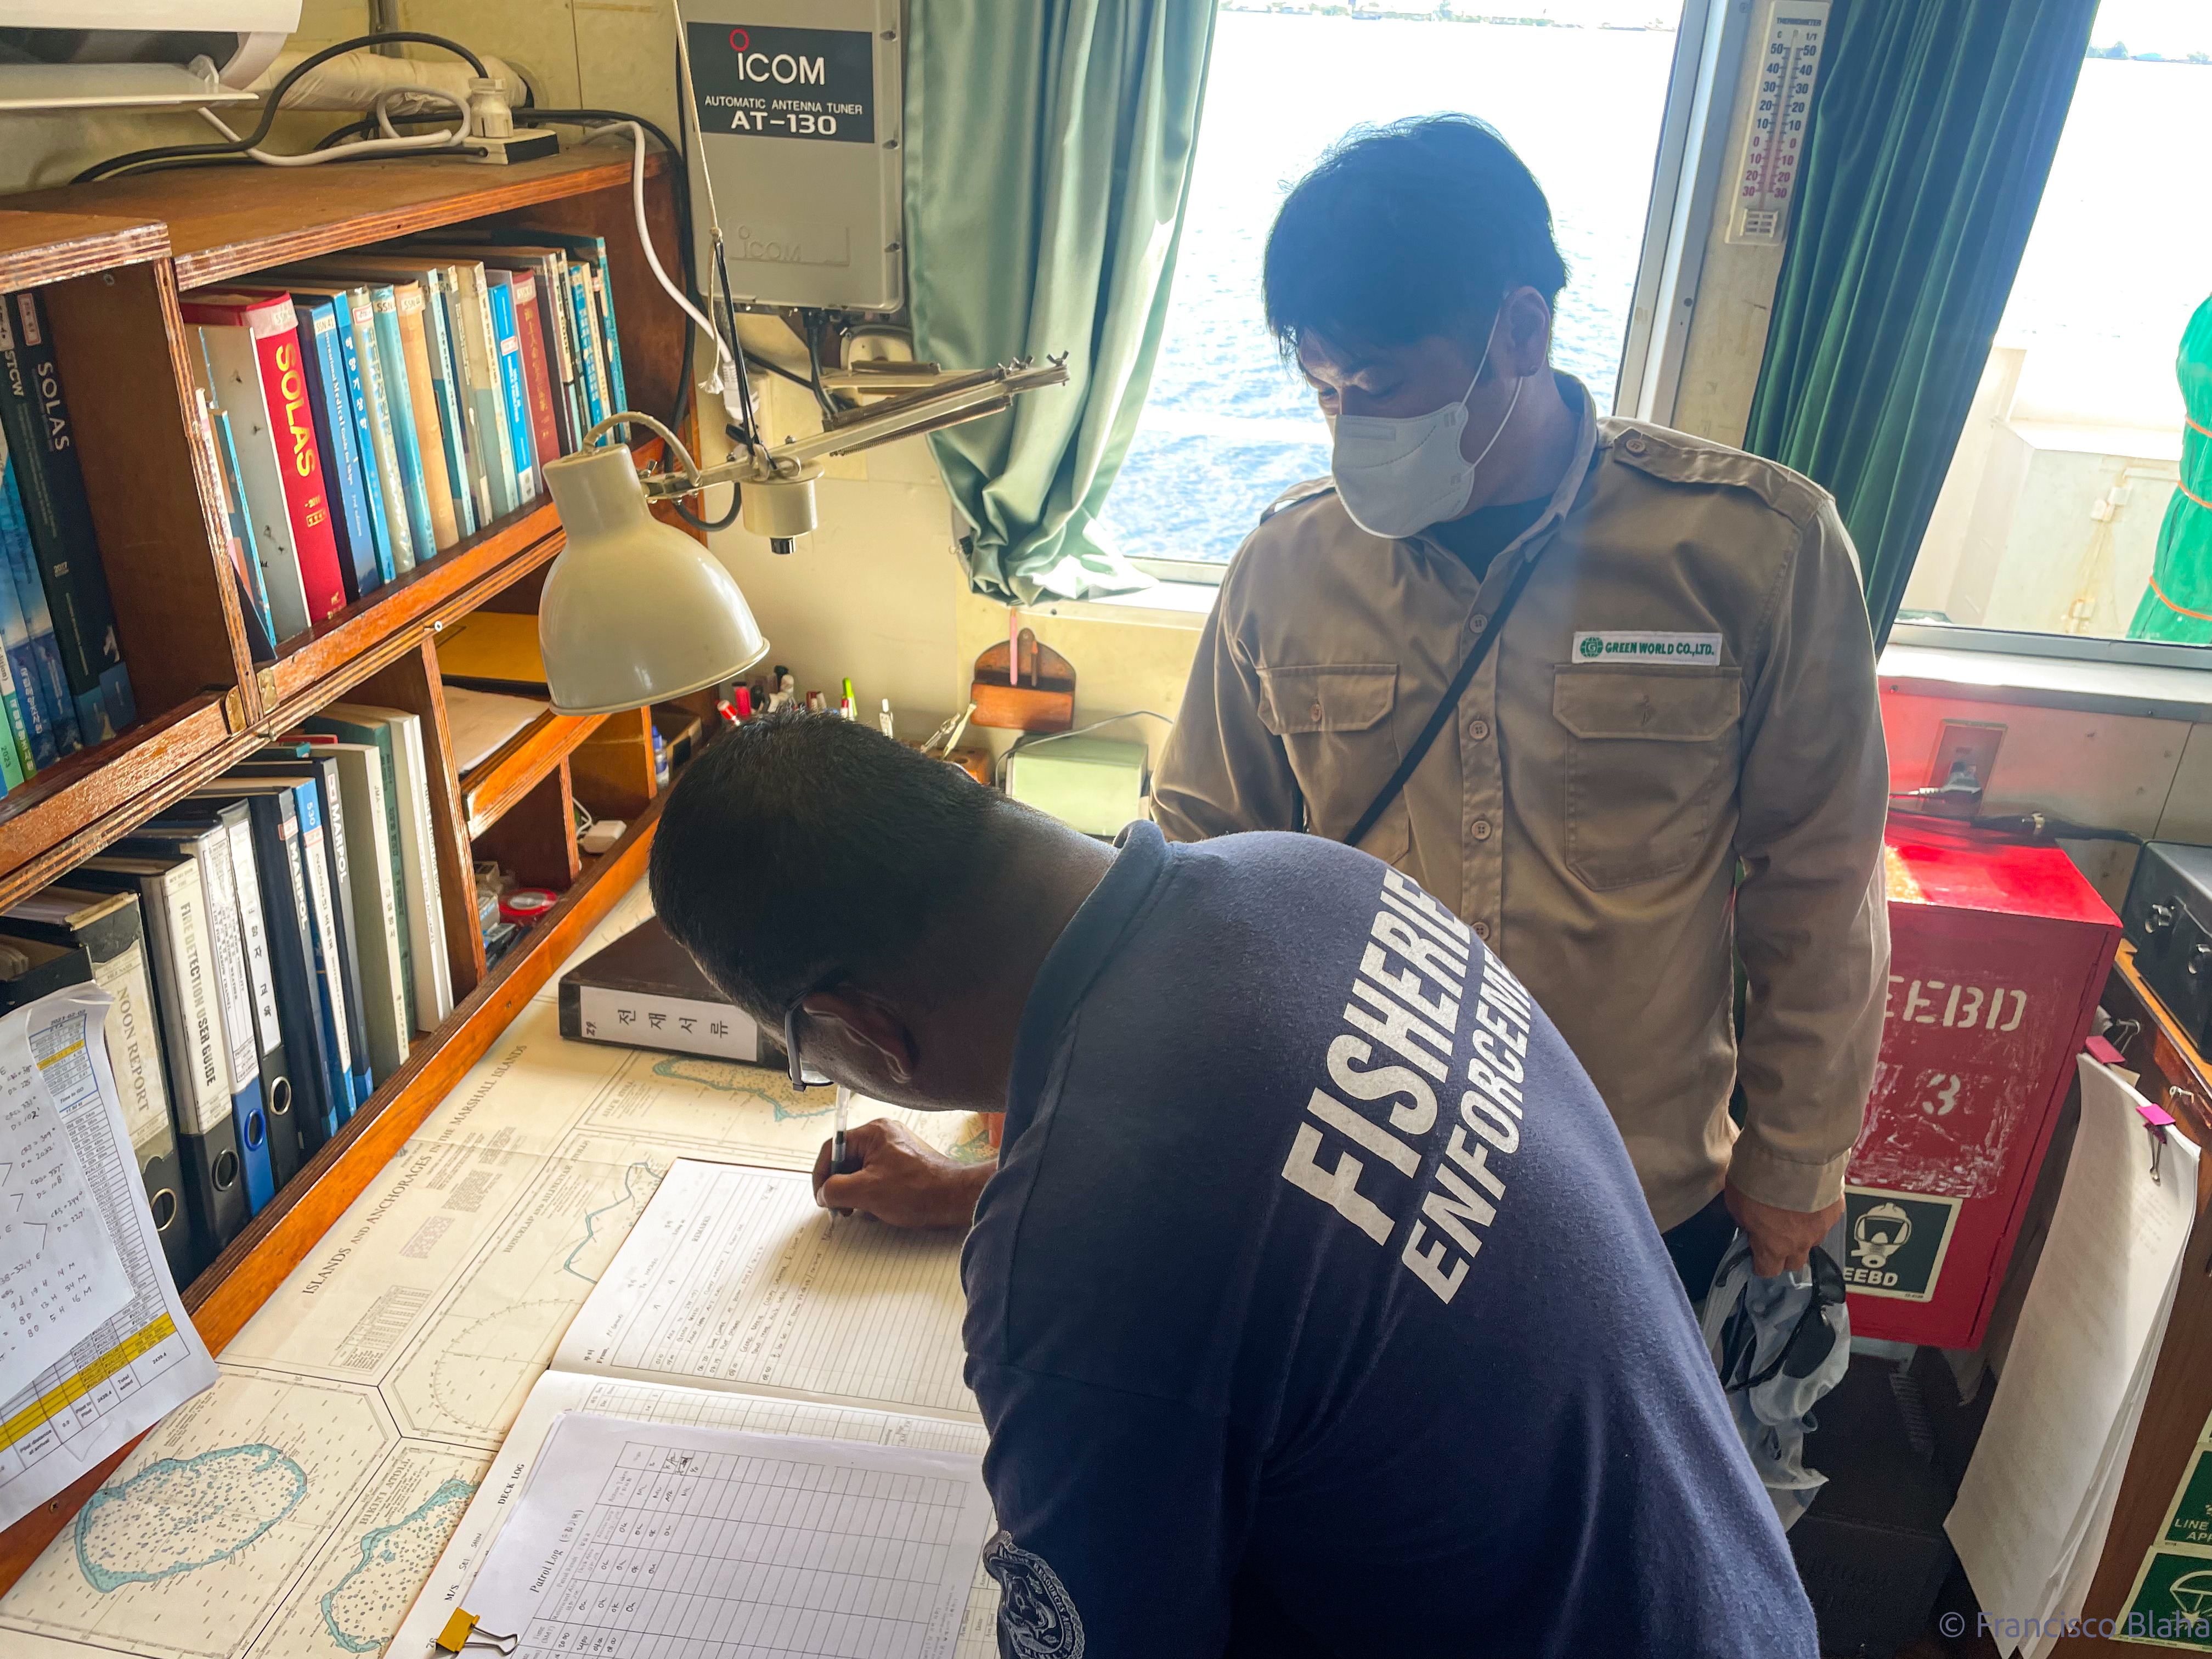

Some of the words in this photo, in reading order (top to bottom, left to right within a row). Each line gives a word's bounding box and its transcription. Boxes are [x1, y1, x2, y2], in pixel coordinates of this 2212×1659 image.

[1777, 18, 1821, 26] THERMOMETER
[1771, 43, 1783, 54] 50
[1803, 45, 1816, 56] 50
[1767, 63, 1779, 74] 40
[1799, 65, 1812, 76] 40
[1764, 82, 1776, 92] 30
[1796, 83, 1808, 94] 30
[705, 96, 766, 109] AUTOMATIC
[772, 100, 822, 113] ANTENNA
[827, 103, 862, 115] TUNER
[1760, 100, 1771, 111] 20
[1792, 102, 1804, 113] 20
[731, 110, 837, 136] AT-130
[1757, 118, 1768, 129] 10
[1789, 120, 1801, 131] 10
[1753, 137, 1759, 146] 0
[1790, 138, 1796, 149] 0
[1750, 154, 1762, 164] 10
[1782, 155, 1793, 166] 10
[1746, 170, 1758, 180] 20
[1778, 172, 1790, 182] 20
[1743, 186, 1754, 196] 30
[1774, 188, 1787, 198] 30
[5, 349, 24, 397] STCW
[38, 362, 70, 450] SOLAS
[275, 343, 315, 477] SOLAS
[333, 382, 346, 427] Medical
[1605, 641, 1637, 654] GREEN
[1639, 642, 1674, 655] WORLD
[307, 802, 316, 826] 530
[331, 803, 347, 883] MARPOL
[289, 842, 308, 931] MARPOL
[180, 902, 192, 931] FIRE
[184, 933, 205, 1007] DETECTION
[195, 1007, 210, 1045] USER
[117, 986, 136, 1040] NOON
[128, 1040, 150, 1111] REPORT
[1281, 868, 1471, 1247] FISHERIE
[201, 1044, 216, 1087] GUIDE
[60, 1095, 71, 1104] Time
[1922, 1074, 1961, 1116] 3
[1401, 943, 1531, 1305] ENFORCEME
[302, 1247, 352, 1296] ISLANDS
[350, 1226, 370, 1245] AND
[366, 1154, 432, 1224] ANCHORAGES
[439, 1126, 456, 1145] THE
[449, 1080, 498, 1126] MARSHALL
[492, 1045, 527, 1079] ISLANDS
[691, 1215, 712, 1243] REMARKS
[69, 1262, 75, 1270] M
[1843, 1267, 1898, 1286] EEBD
[65, 1282, 75, 1293] 34
[78, 1274, 87, 1283] M
[50, 1313, 57, 1323] 5
[59, 1305, 65, 1314] H
[72, 1293, 81, 1303] 16
[83, 1286, 92, 1297] M
[117, 1374, 129, 1385] Total
[120, 1379, 133, 1391] sailed
[31, 1429, 52, 1445] distance
[35, 1439, 50, 1452] arrival
[359, 1491, 387, 1525] BIKINI
[386, 1459, 410, 1488] ATOLL
[498, 1482, 516, 1505] DECK
[511, 1463, 525, 1481] LOG
[2174, 1518, 2209, 1531] LINE
[529, 1566, 552, 1594] Patrol
[544, 1549, 564, 1566] Log
[611, 1602, 619, 1613] OK
[631, 1565, 639, 1573] OK
[648, 1529, 656, 1537] OK
[444, 1583, 460, 1601] M/S
[533, 1626, 546, 1640] Time
